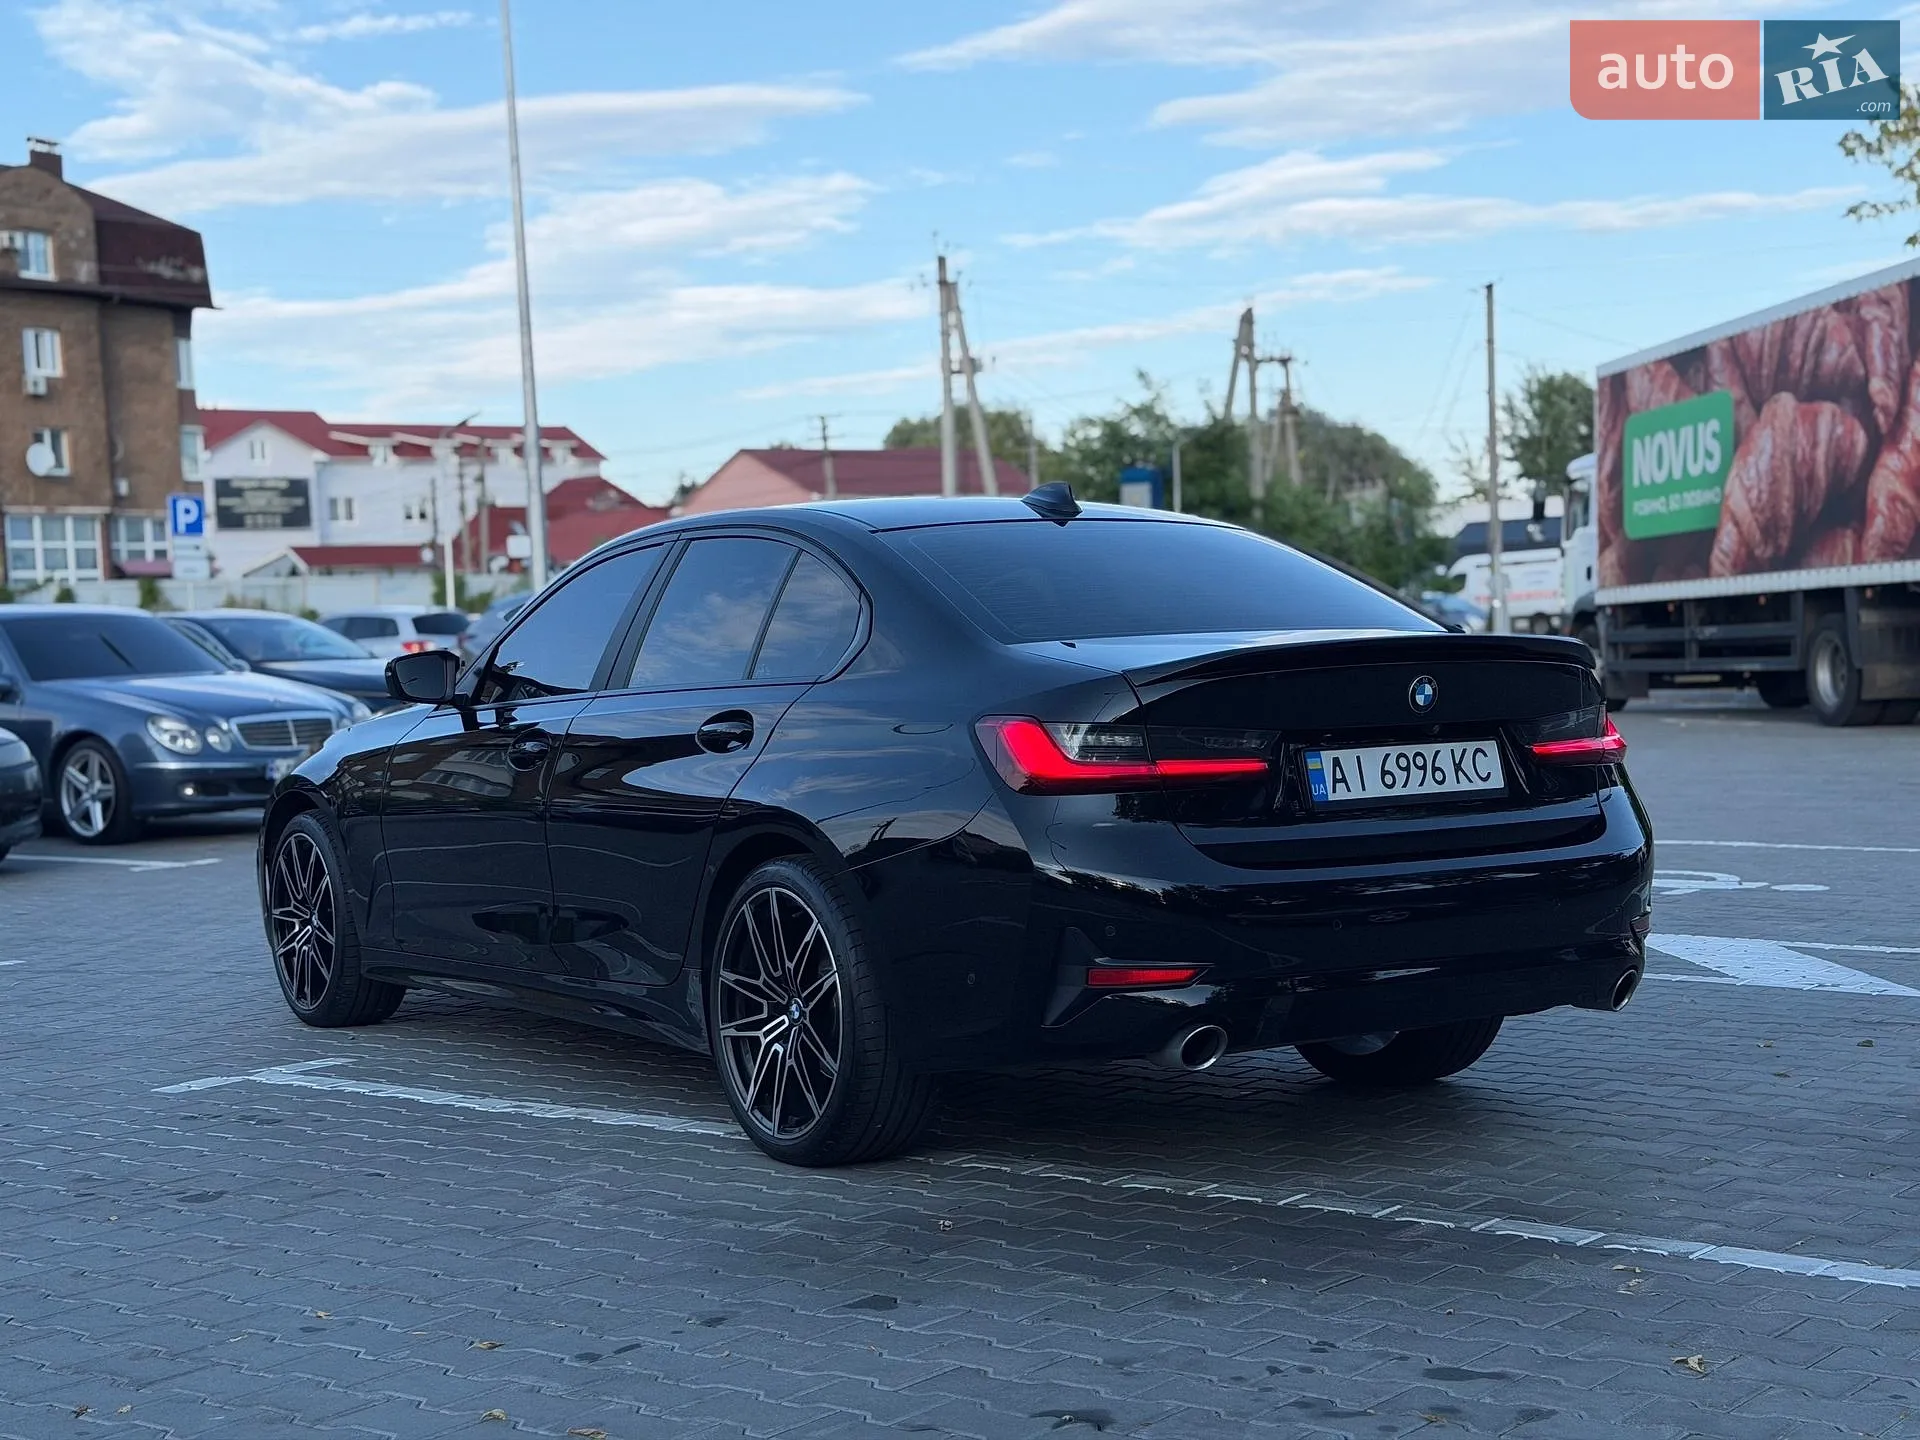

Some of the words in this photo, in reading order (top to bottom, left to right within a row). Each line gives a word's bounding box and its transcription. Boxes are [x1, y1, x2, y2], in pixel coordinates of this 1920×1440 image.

[1632, 418, 1722, 488] NOVUS
[175, 498, 200, 535] P
[1311, 783, 1327, 796] UA
[1331, 755, 1367, 794] AI
[1380, 750, 1447, 790] 6996
[1450, 748, 1492, 785] KC
